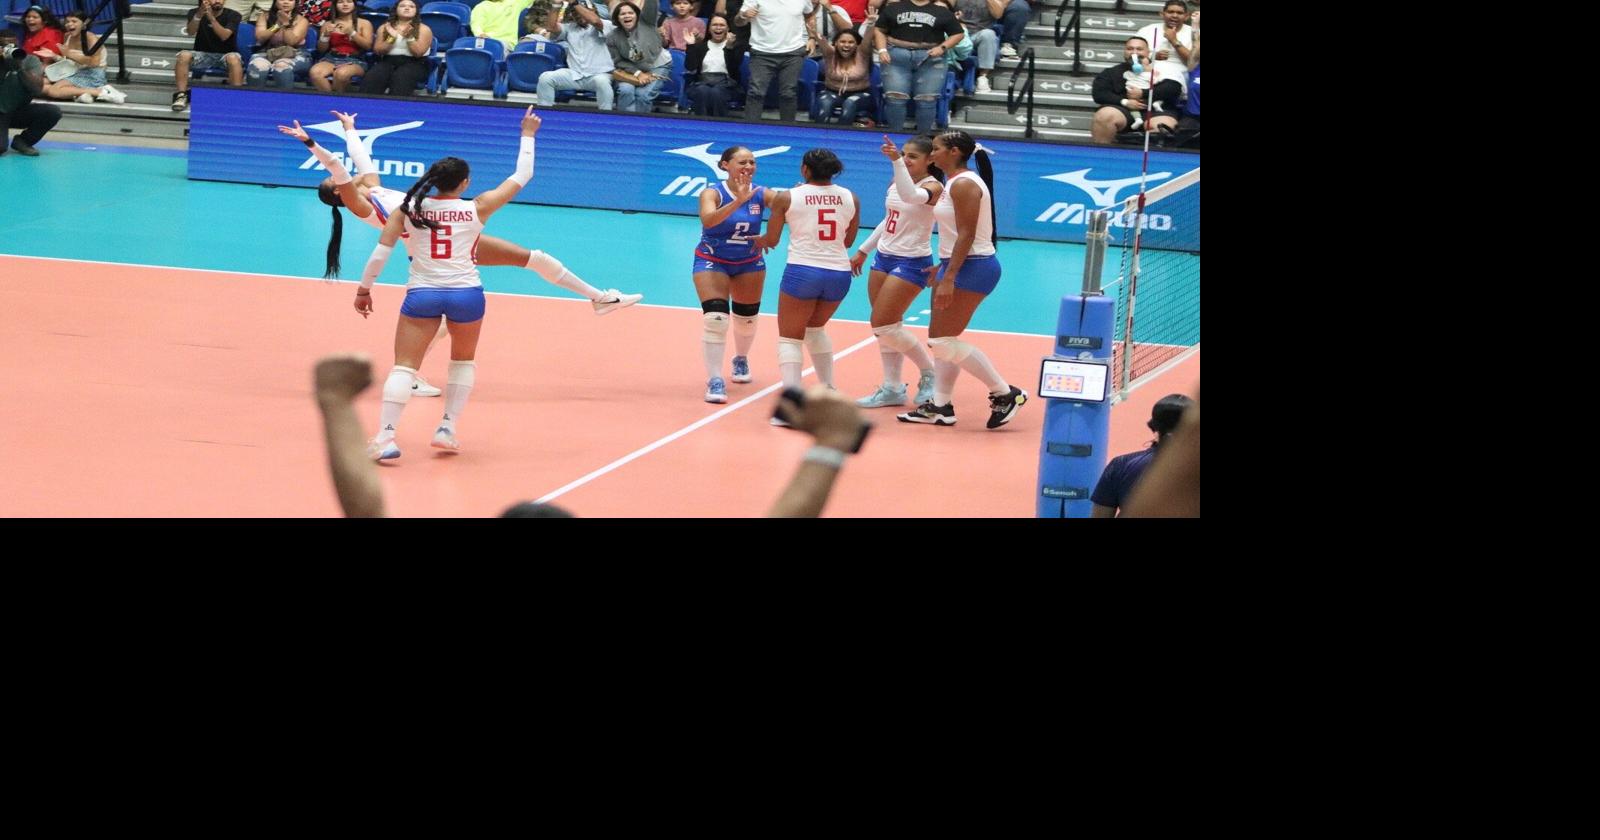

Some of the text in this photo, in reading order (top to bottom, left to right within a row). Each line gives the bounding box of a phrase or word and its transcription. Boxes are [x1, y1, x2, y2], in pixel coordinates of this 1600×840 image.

[1105, 18, 1116, 27] E
[1084, 50, 1095, 59] D
[141, 57, 151, 67] B
[1060, 81, 1072, 91] C
[1037, 115, 1049, 125] B
[805, 194, 843, 206] RIVERA
[817, 208, 837, 241] 5
[726, 222, 750, 245] 2
[430, 225, 452, 259] 6
[705, 261, 714, 269] 2
